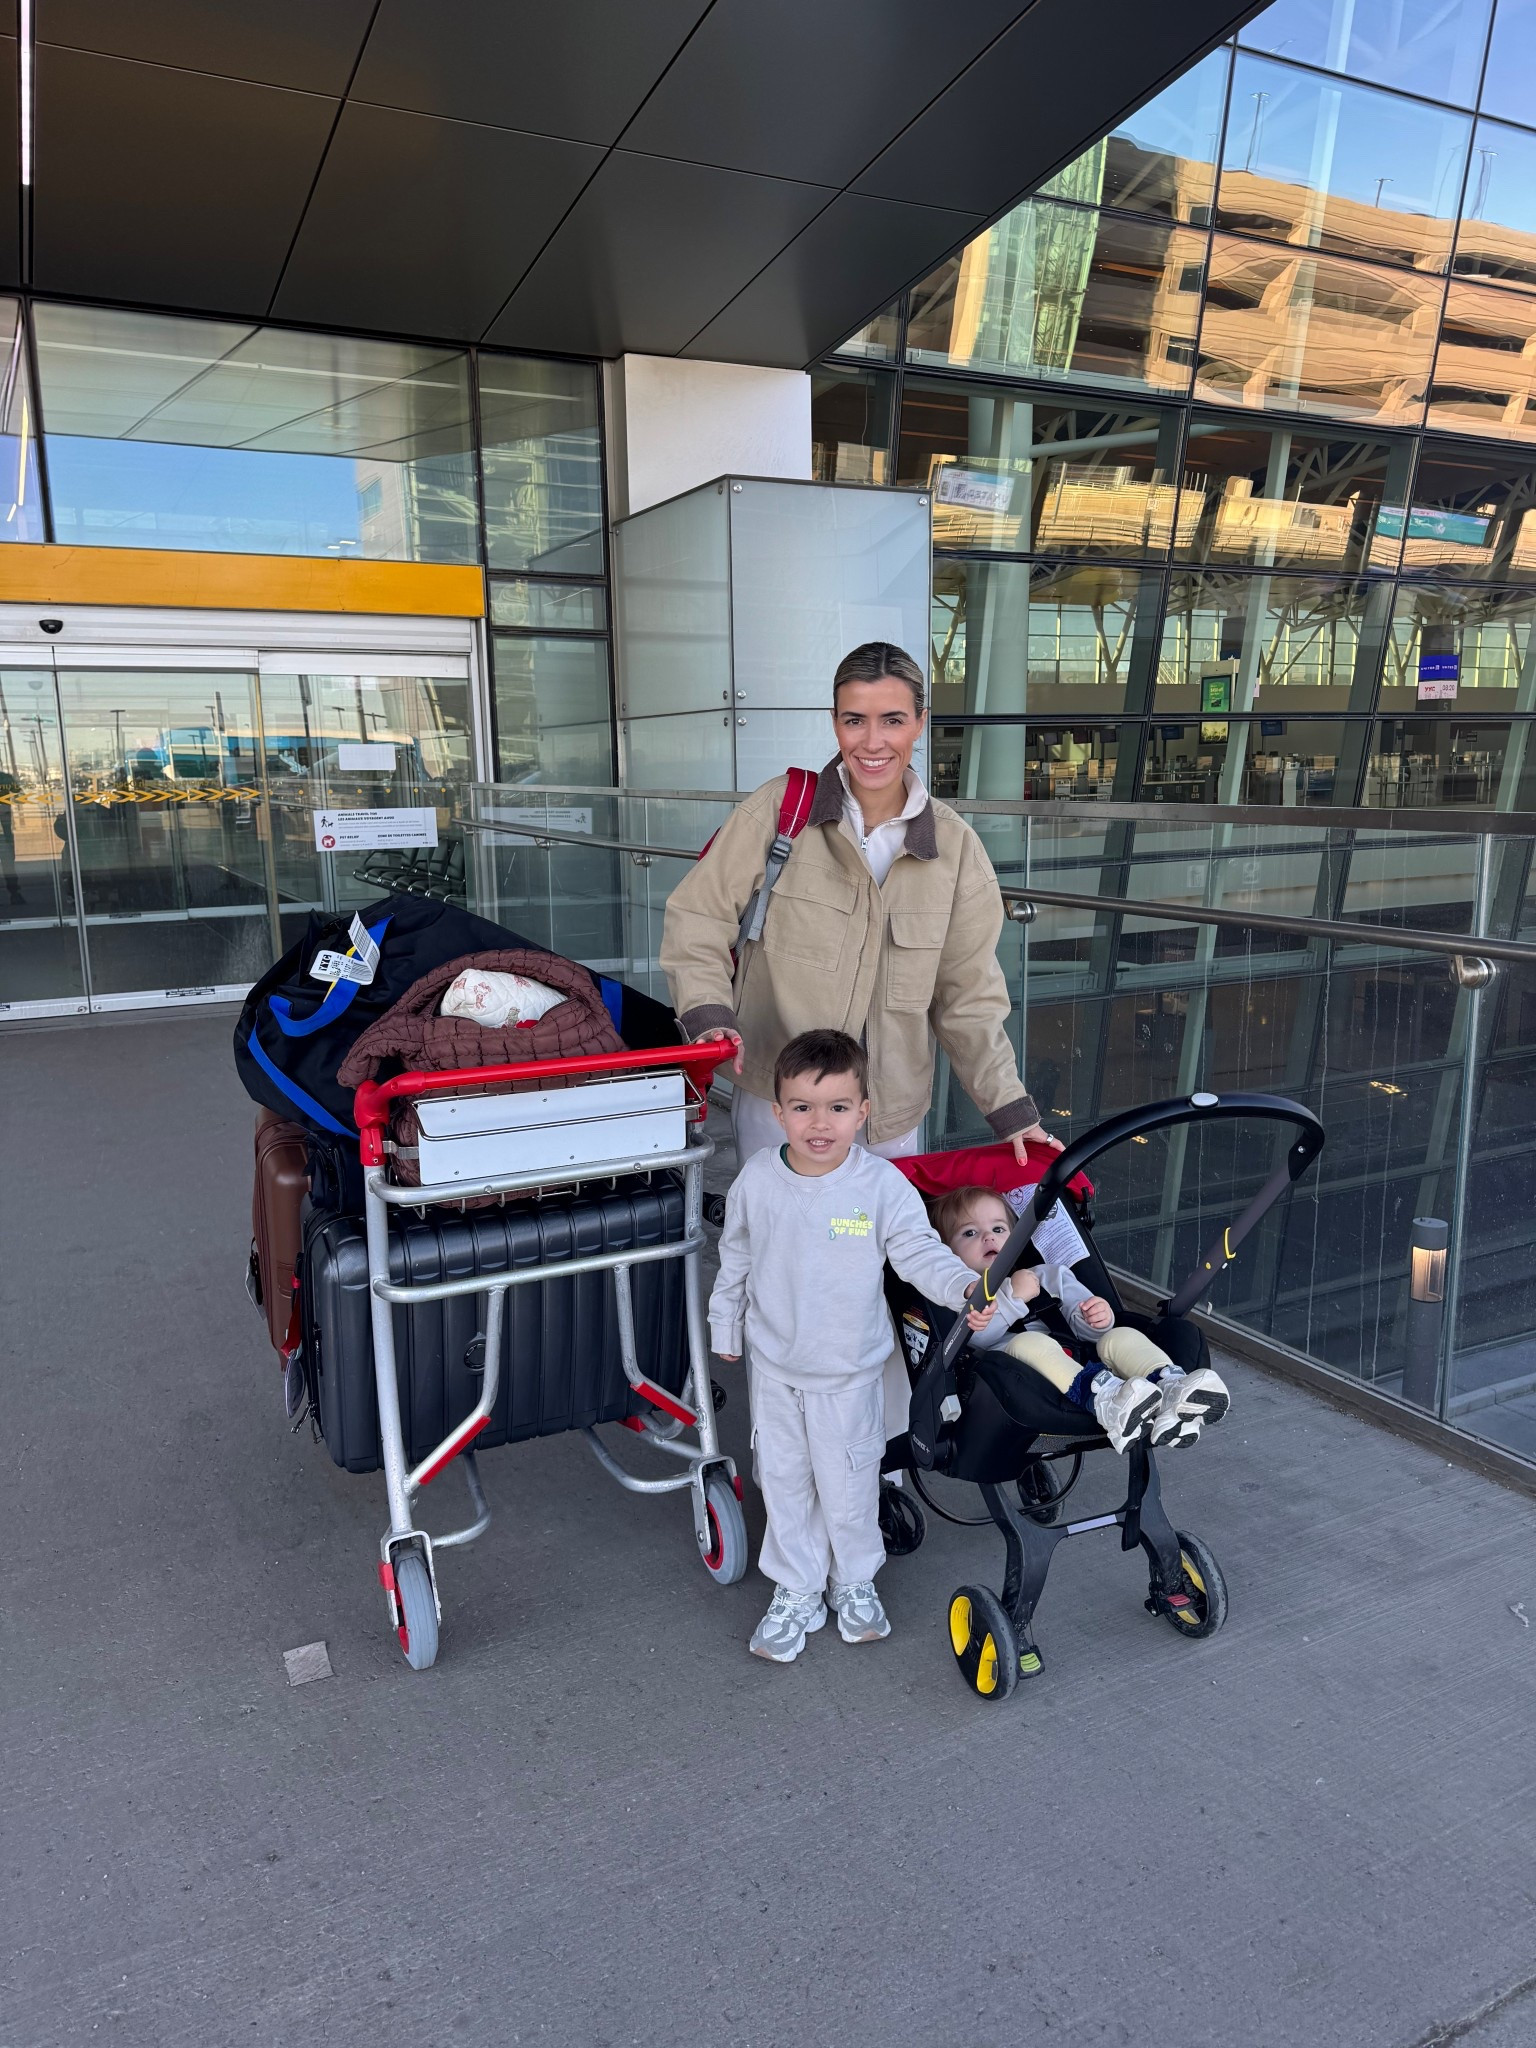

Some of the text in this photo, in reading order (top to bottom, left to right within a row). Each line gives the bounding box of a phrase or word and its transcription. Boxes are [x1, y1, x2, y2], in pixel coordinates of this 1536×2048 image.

[319, 954, 332, 971] YYC
[830, 1217, 873, 1229] BUNCHES
[834, 1226, 868, 1237] OF FUN
